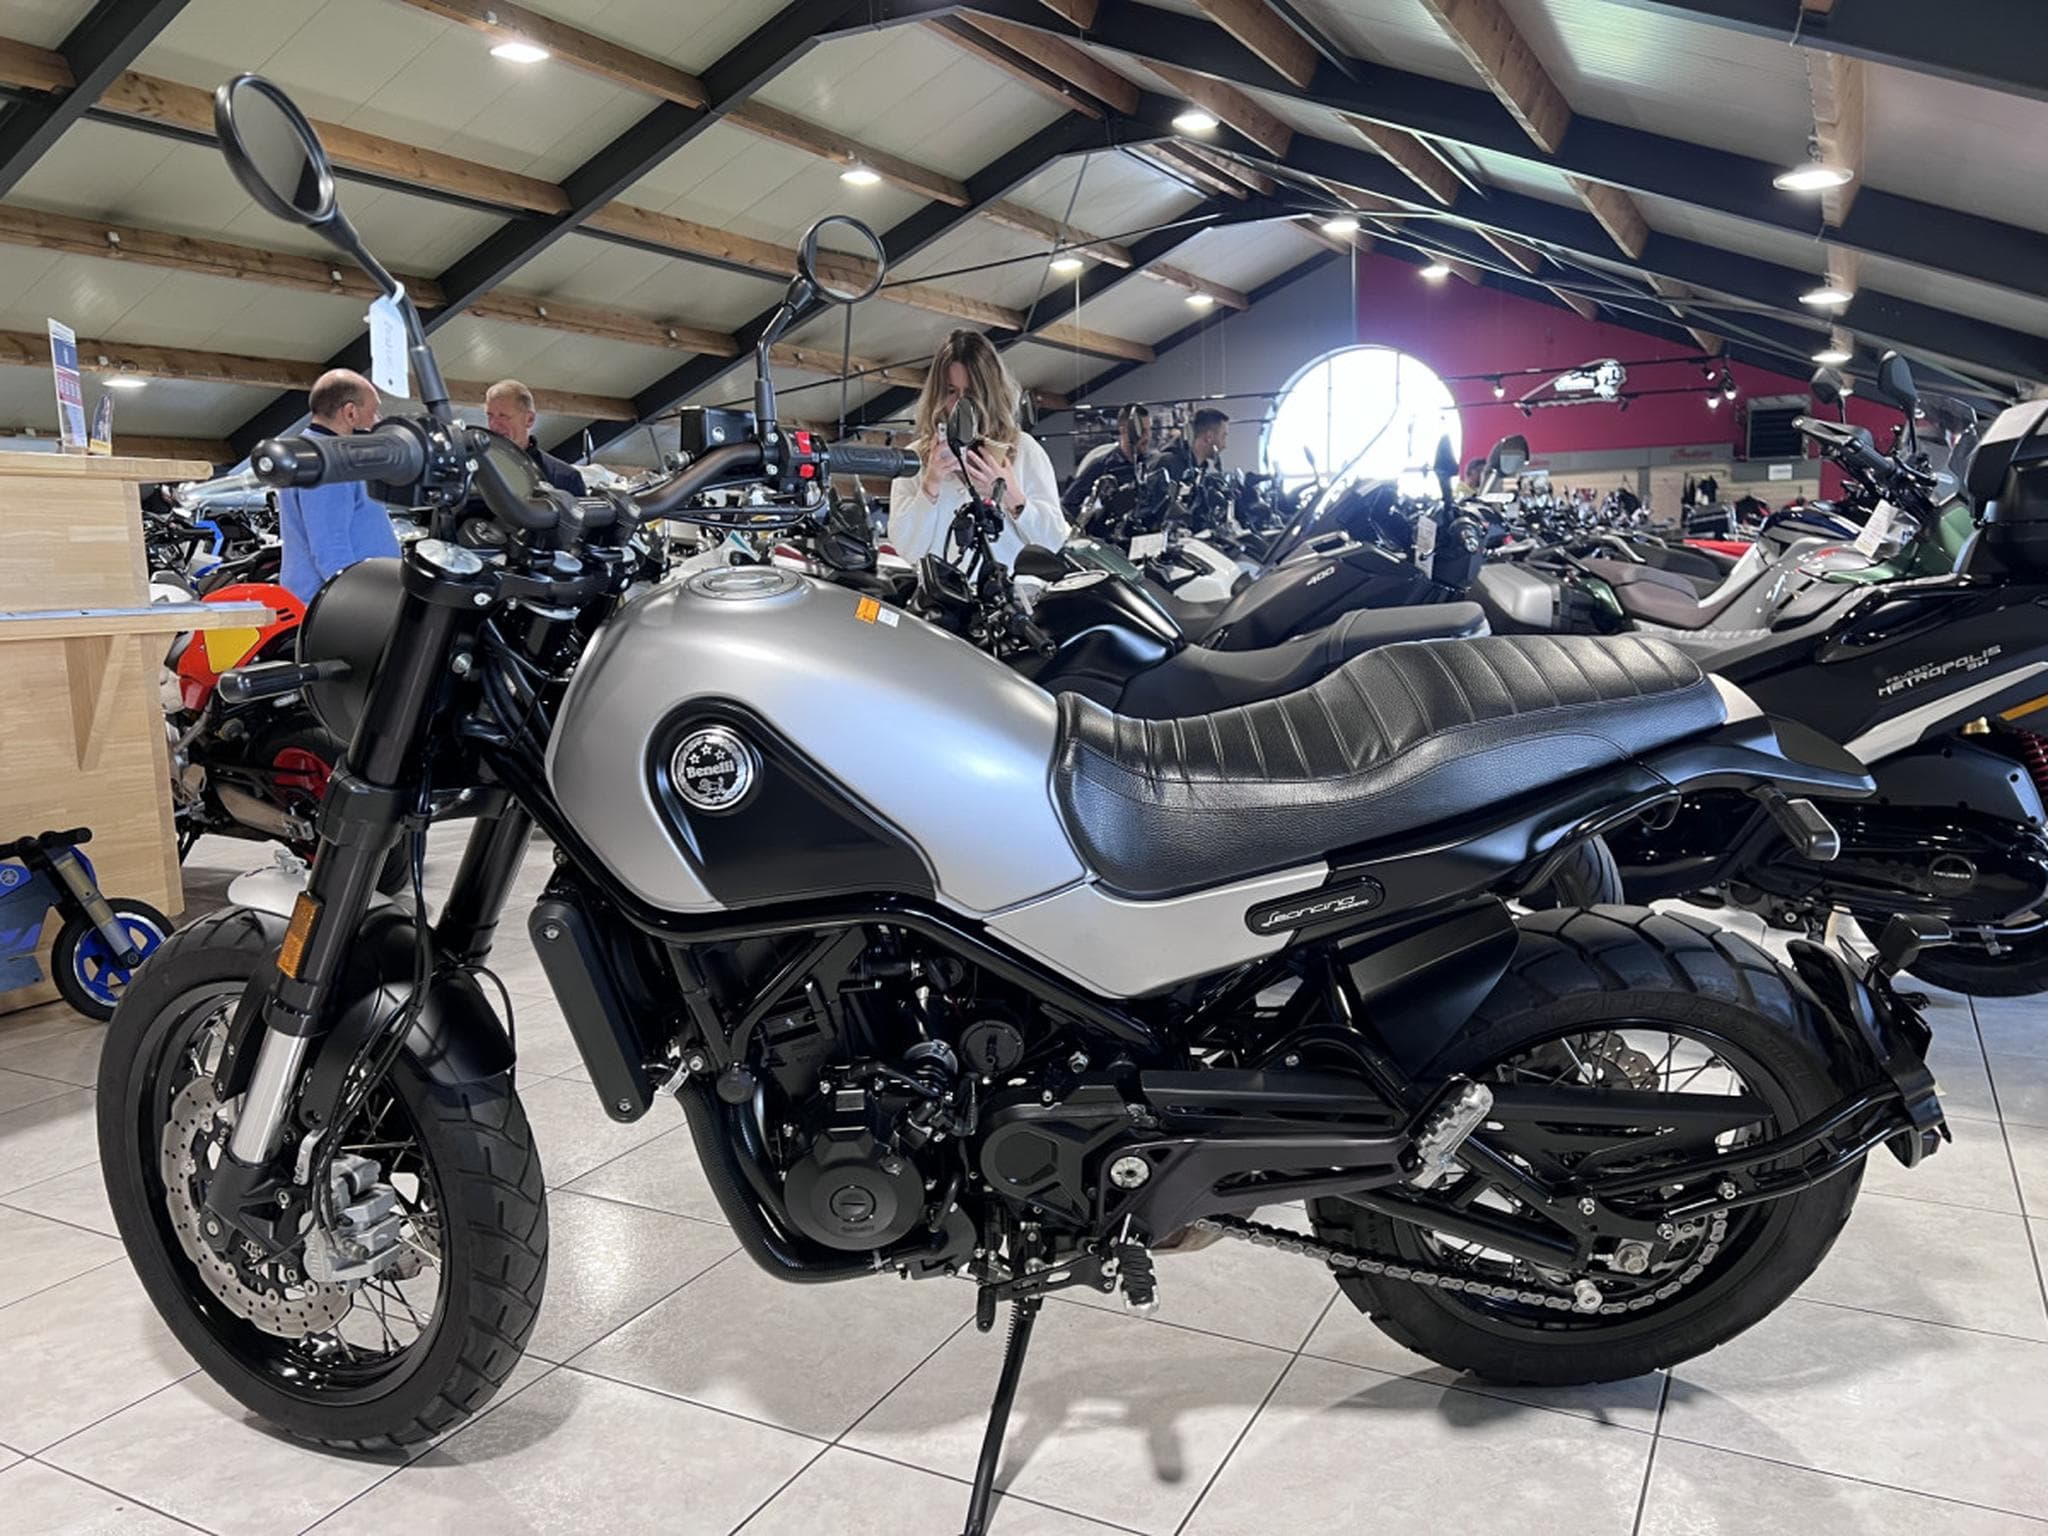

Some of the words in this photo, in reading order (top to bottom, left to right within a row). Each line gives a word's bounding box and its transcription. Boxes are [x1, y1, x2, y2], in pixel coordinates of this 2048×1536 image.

[1306, 566, 1336, 586] 400
[1878, 644, 2002, 697] METROPOLIS
[686, 760, 735, 779] Benelli
